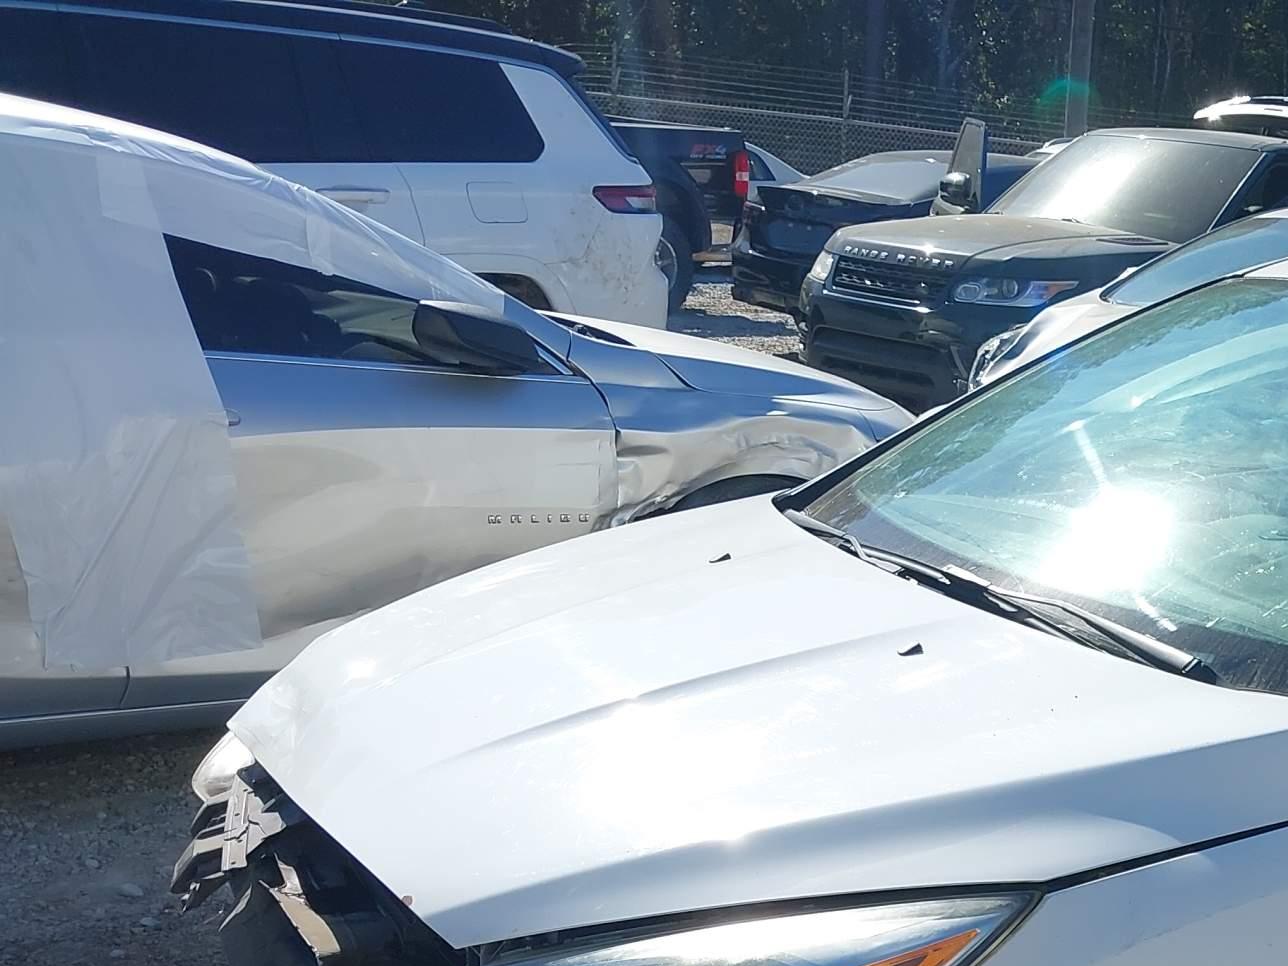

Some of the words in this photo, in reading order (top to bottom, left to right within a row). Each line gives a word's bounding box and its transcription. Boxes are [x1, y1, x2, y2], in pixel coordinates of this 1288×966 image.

[844, 245, 889, 260] RANGE
[896, 253, 954, 269] ROVER
[487, 513, 589, 524] MALIBU
